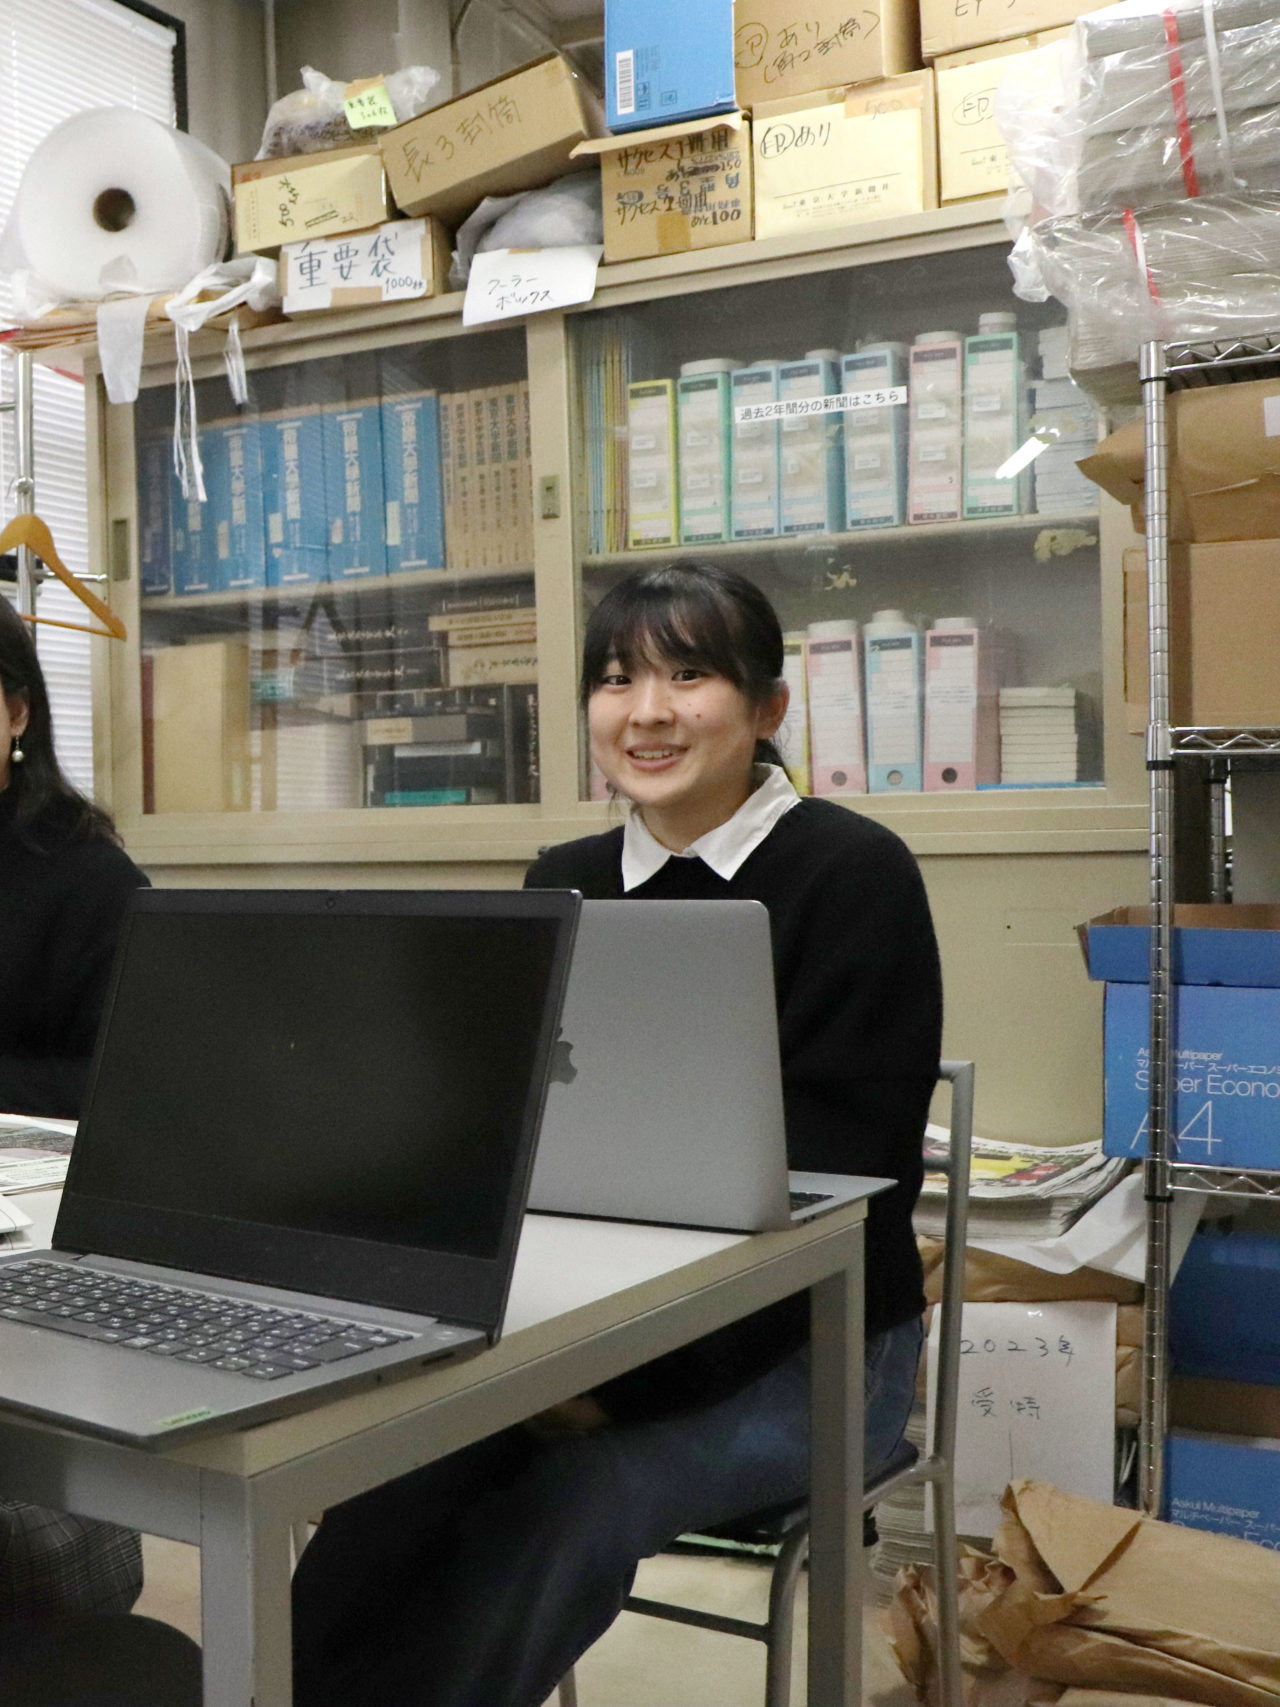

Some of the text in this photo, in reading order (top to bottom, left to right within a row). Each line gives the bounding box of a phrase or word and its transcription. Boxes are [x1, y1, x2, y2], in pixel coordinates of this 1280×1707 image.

[293, 232, 399, 290] 重要袋
[488, 274, 538, 295] クーラー
[496, 290, 553, 311] ボックス
[740, 390, 899, 421] 過去2年間分の新聞はこちら
